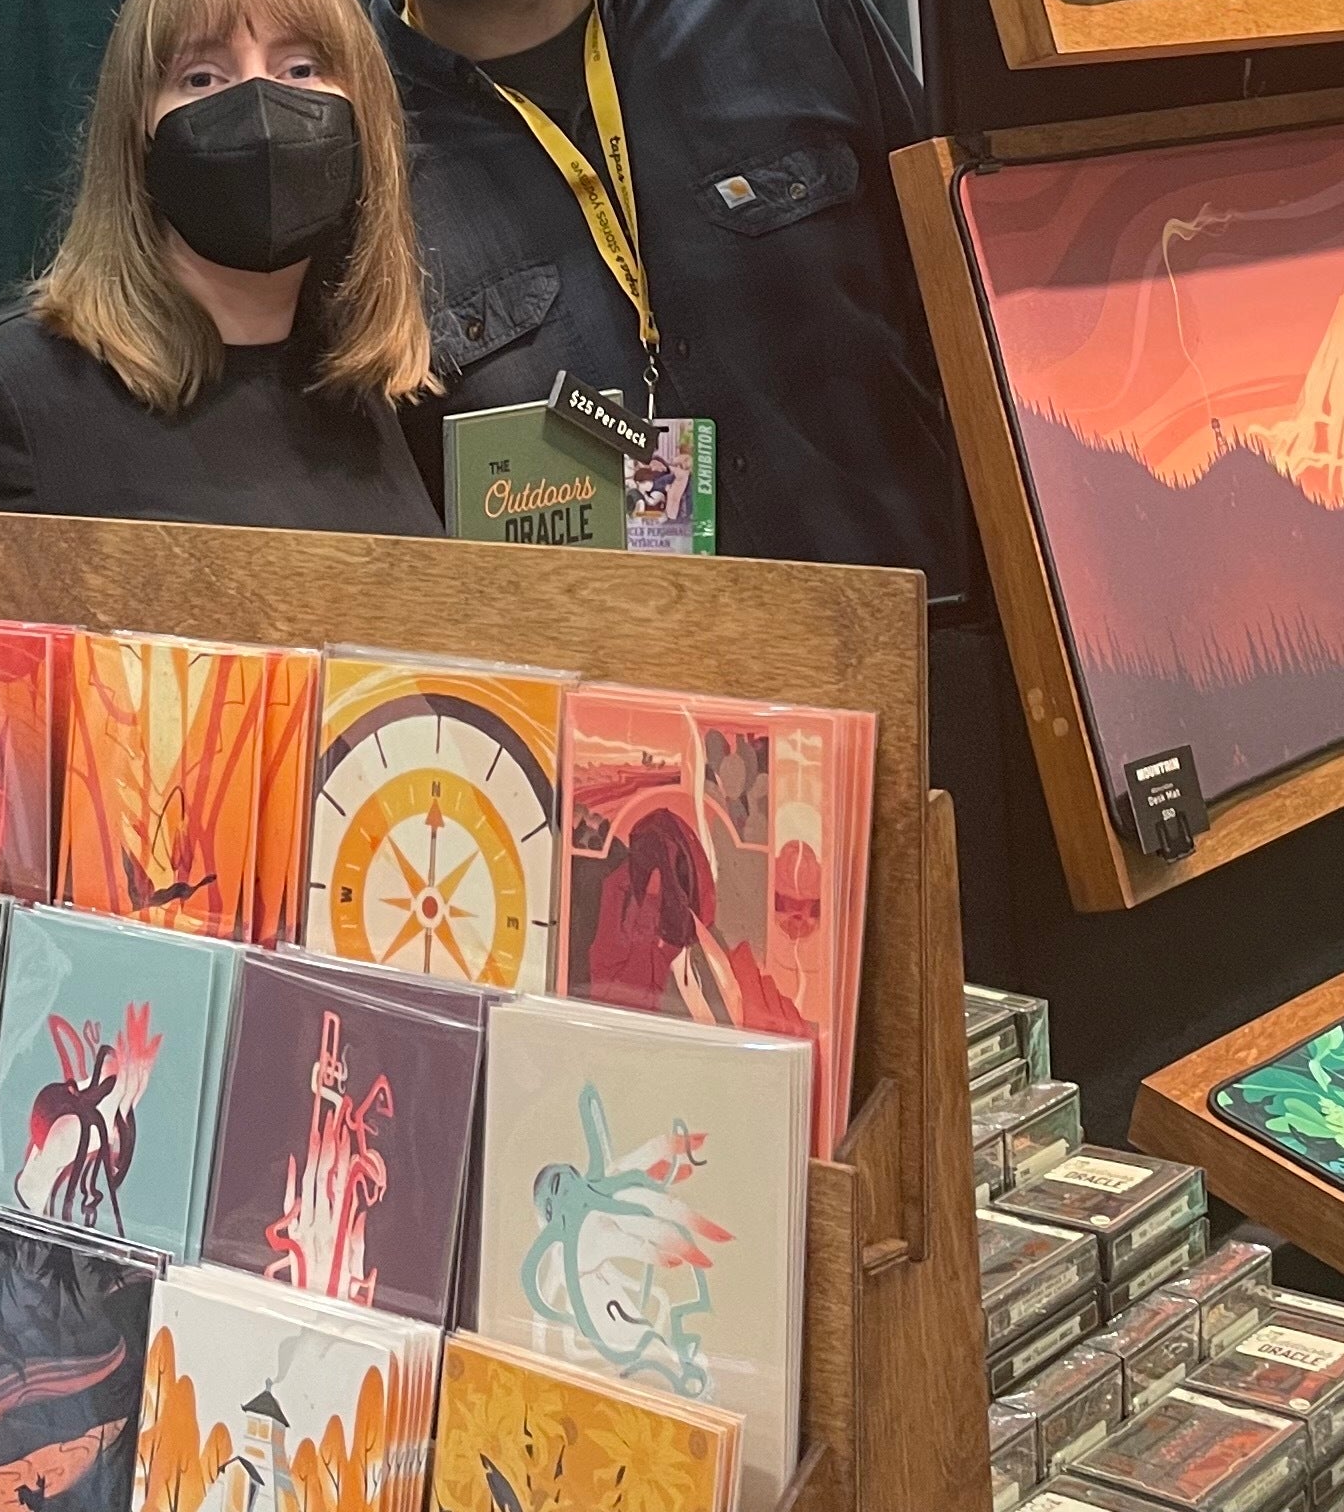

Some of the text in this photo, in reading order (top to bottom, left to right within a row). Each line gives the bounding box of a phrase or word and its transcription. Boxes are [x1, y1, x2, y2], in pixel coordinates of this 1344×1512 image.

[609, 135, 625, 184] tapas
[596, 210, 621, 254] stories
[569, 389, 648, 448] $25 Per Deck
[489, 459, 510, 475] THE
[698, 425, 713, 494] EXHIBITOR
[484, 475, 597, 518] Outdoors
[506, 504, 593, 545] ORACLE
[1064, 1171, 1123, 1188] ORACLE
[1258, 1343, 1326, 1366] ORACLE
